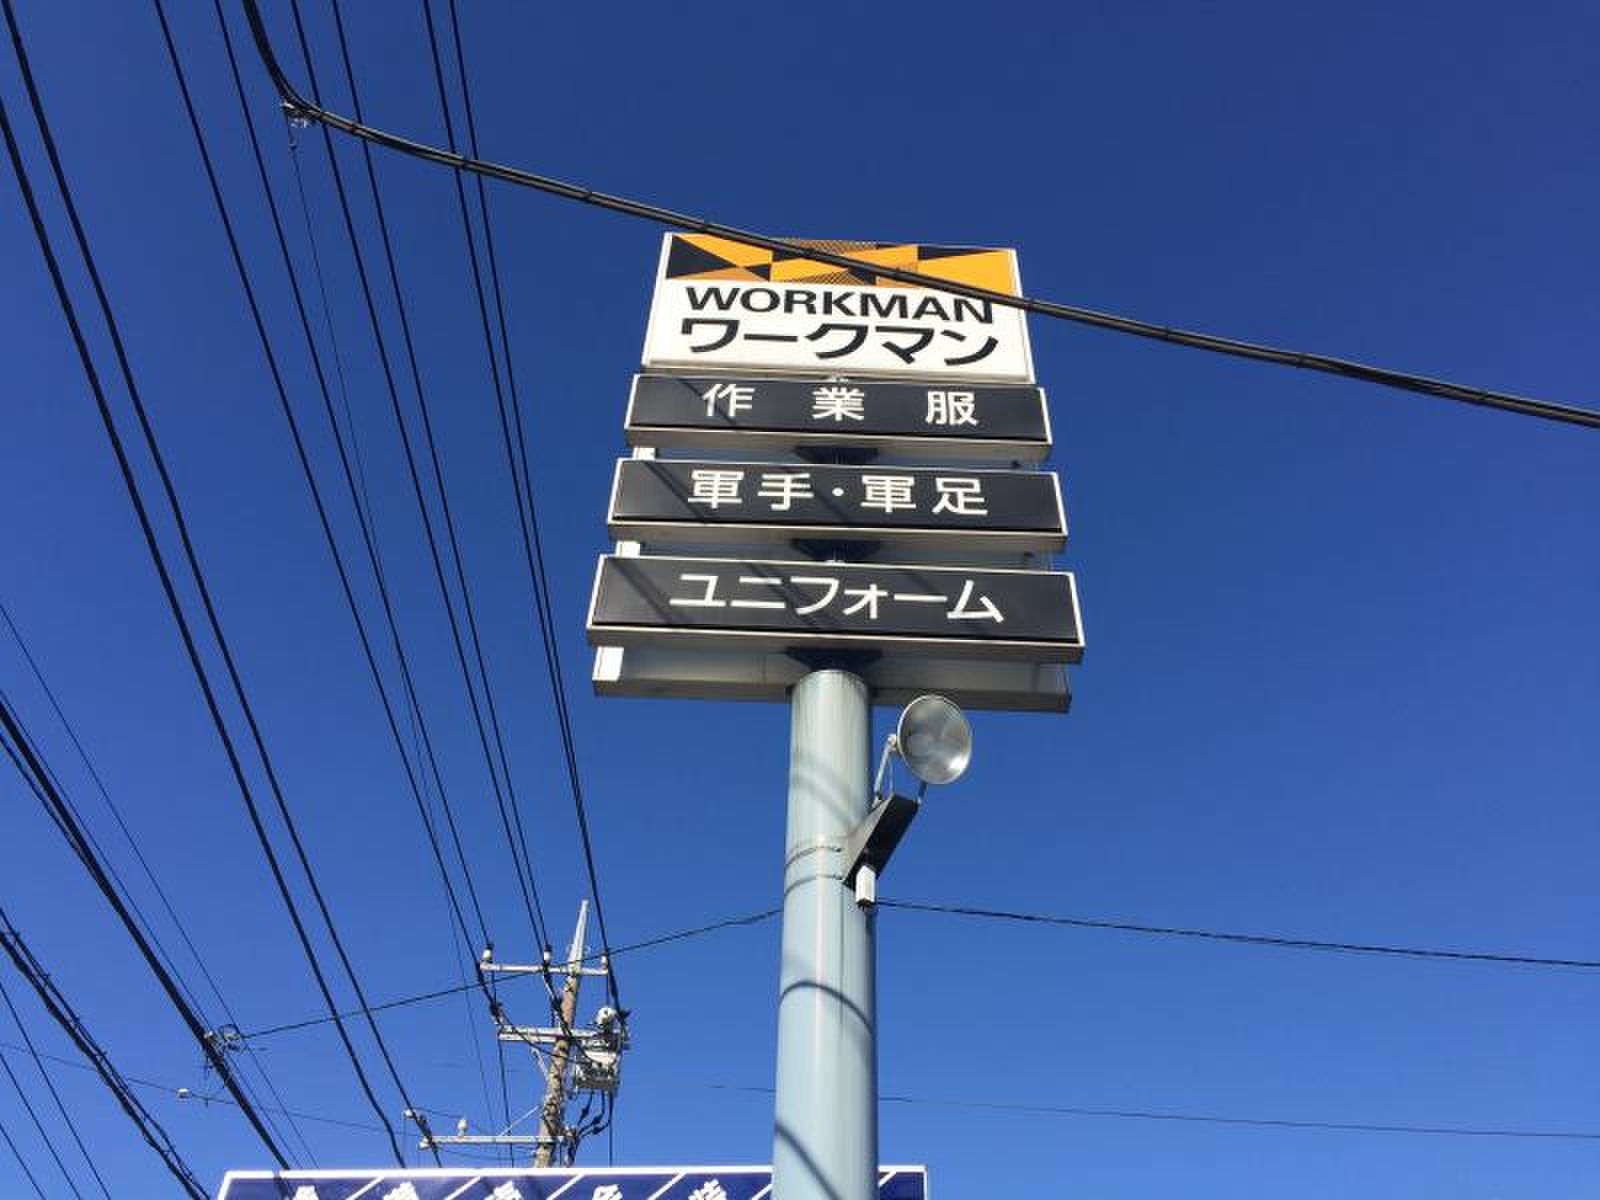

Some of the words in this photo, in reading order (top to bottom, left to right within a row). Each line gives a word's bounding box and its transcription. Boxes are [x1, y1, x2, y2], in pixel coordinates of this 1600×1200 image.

[685, 286, 993, 324] WORKMAN
[681, 317, 998, 365] ワークマン
[702, 383, 978, 426] 作業服
[687, 470, 988, 515] 軍手・軍足
[669, 573, 1004, 623] ユニフォーム
